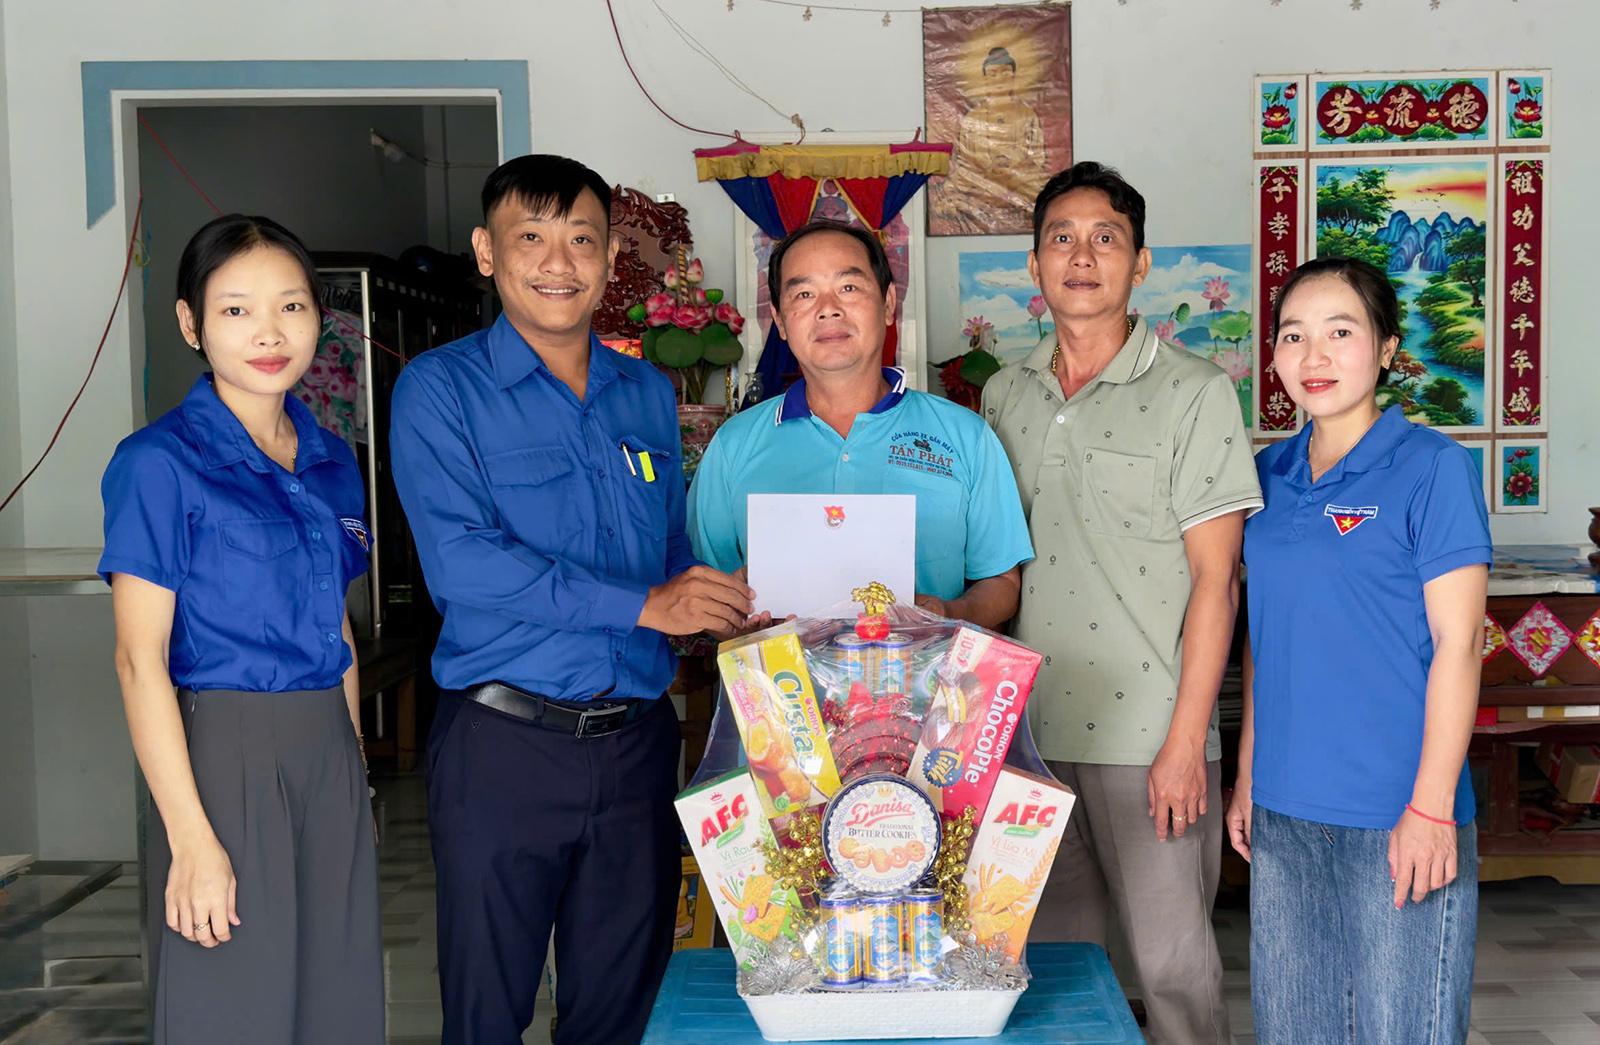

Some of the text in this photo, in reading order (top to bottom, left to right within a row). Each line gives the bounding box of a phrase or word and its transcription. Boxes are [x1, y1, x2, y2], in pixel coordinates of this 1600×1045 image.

[992, 724, 1014, 761] ORION
[701, 793, 750, 848] AFC
[845, 797, 915, 827] Danisa
[993, 802, 1058, 827] AFC
